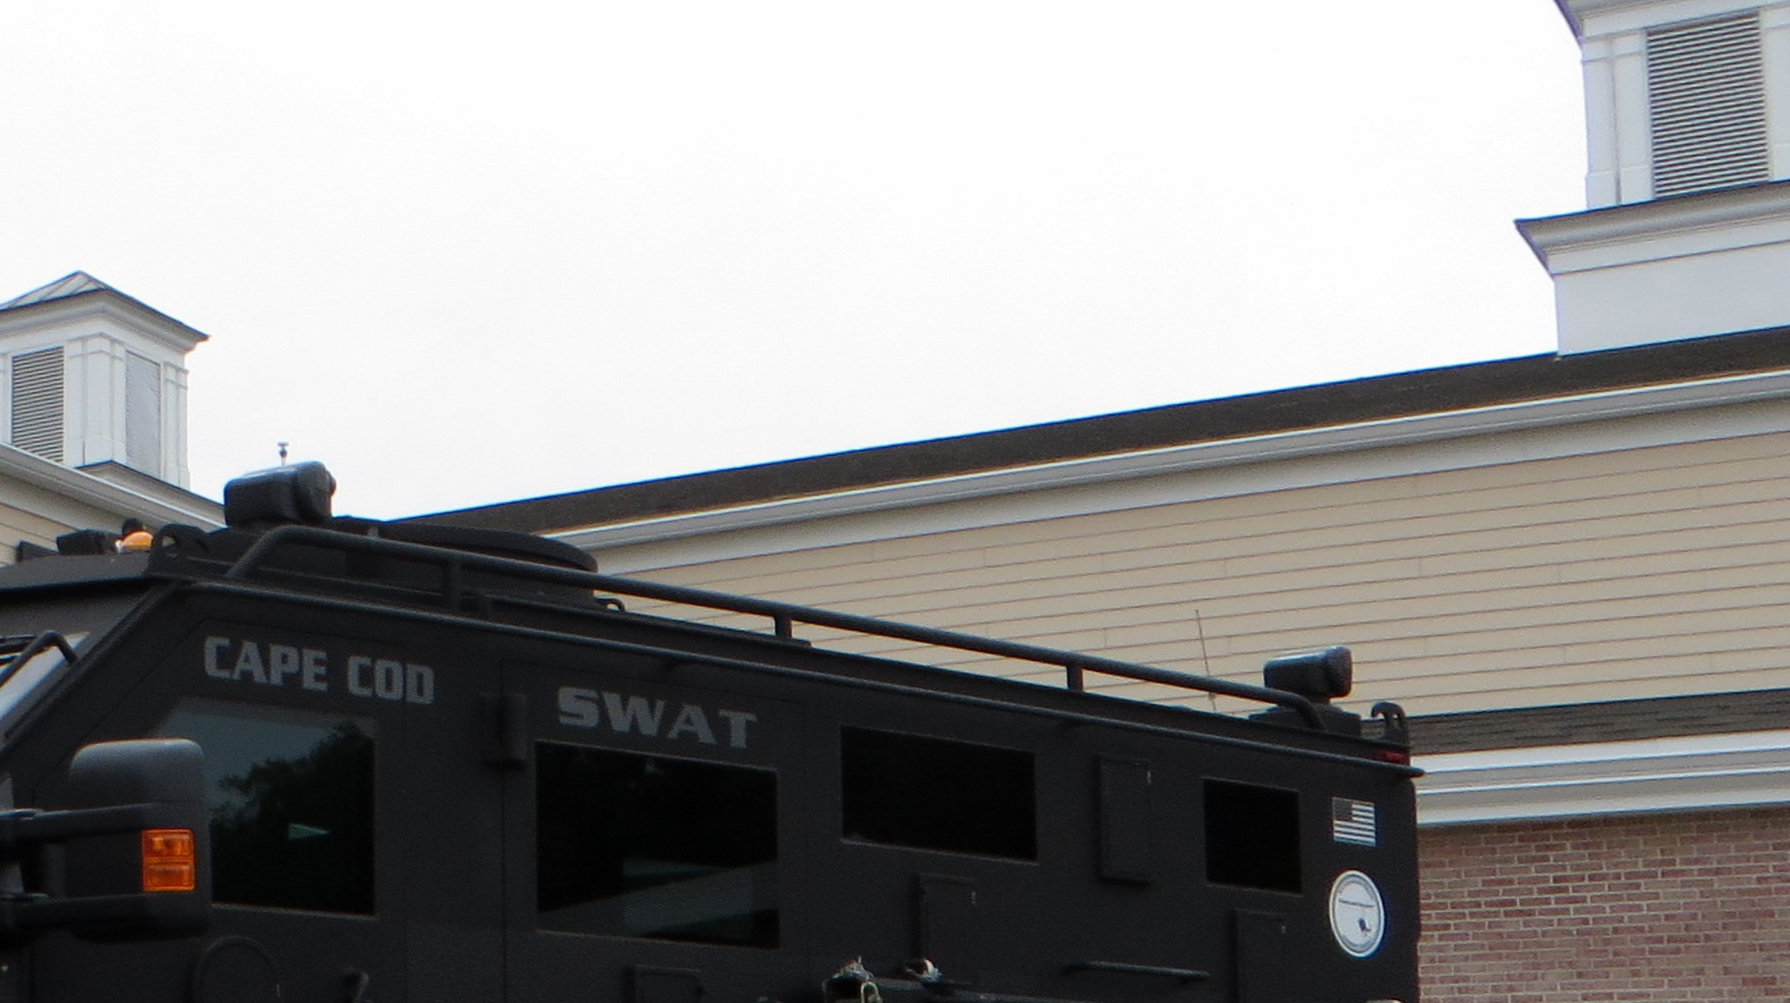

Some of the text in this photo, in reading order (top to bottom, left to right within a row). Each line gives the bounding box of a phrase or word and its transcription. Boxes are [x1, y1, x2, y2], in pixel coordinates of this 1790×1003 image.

[203, 635, 435, 705] CAPE COD
[557, 685, 757, 749] SWAT
